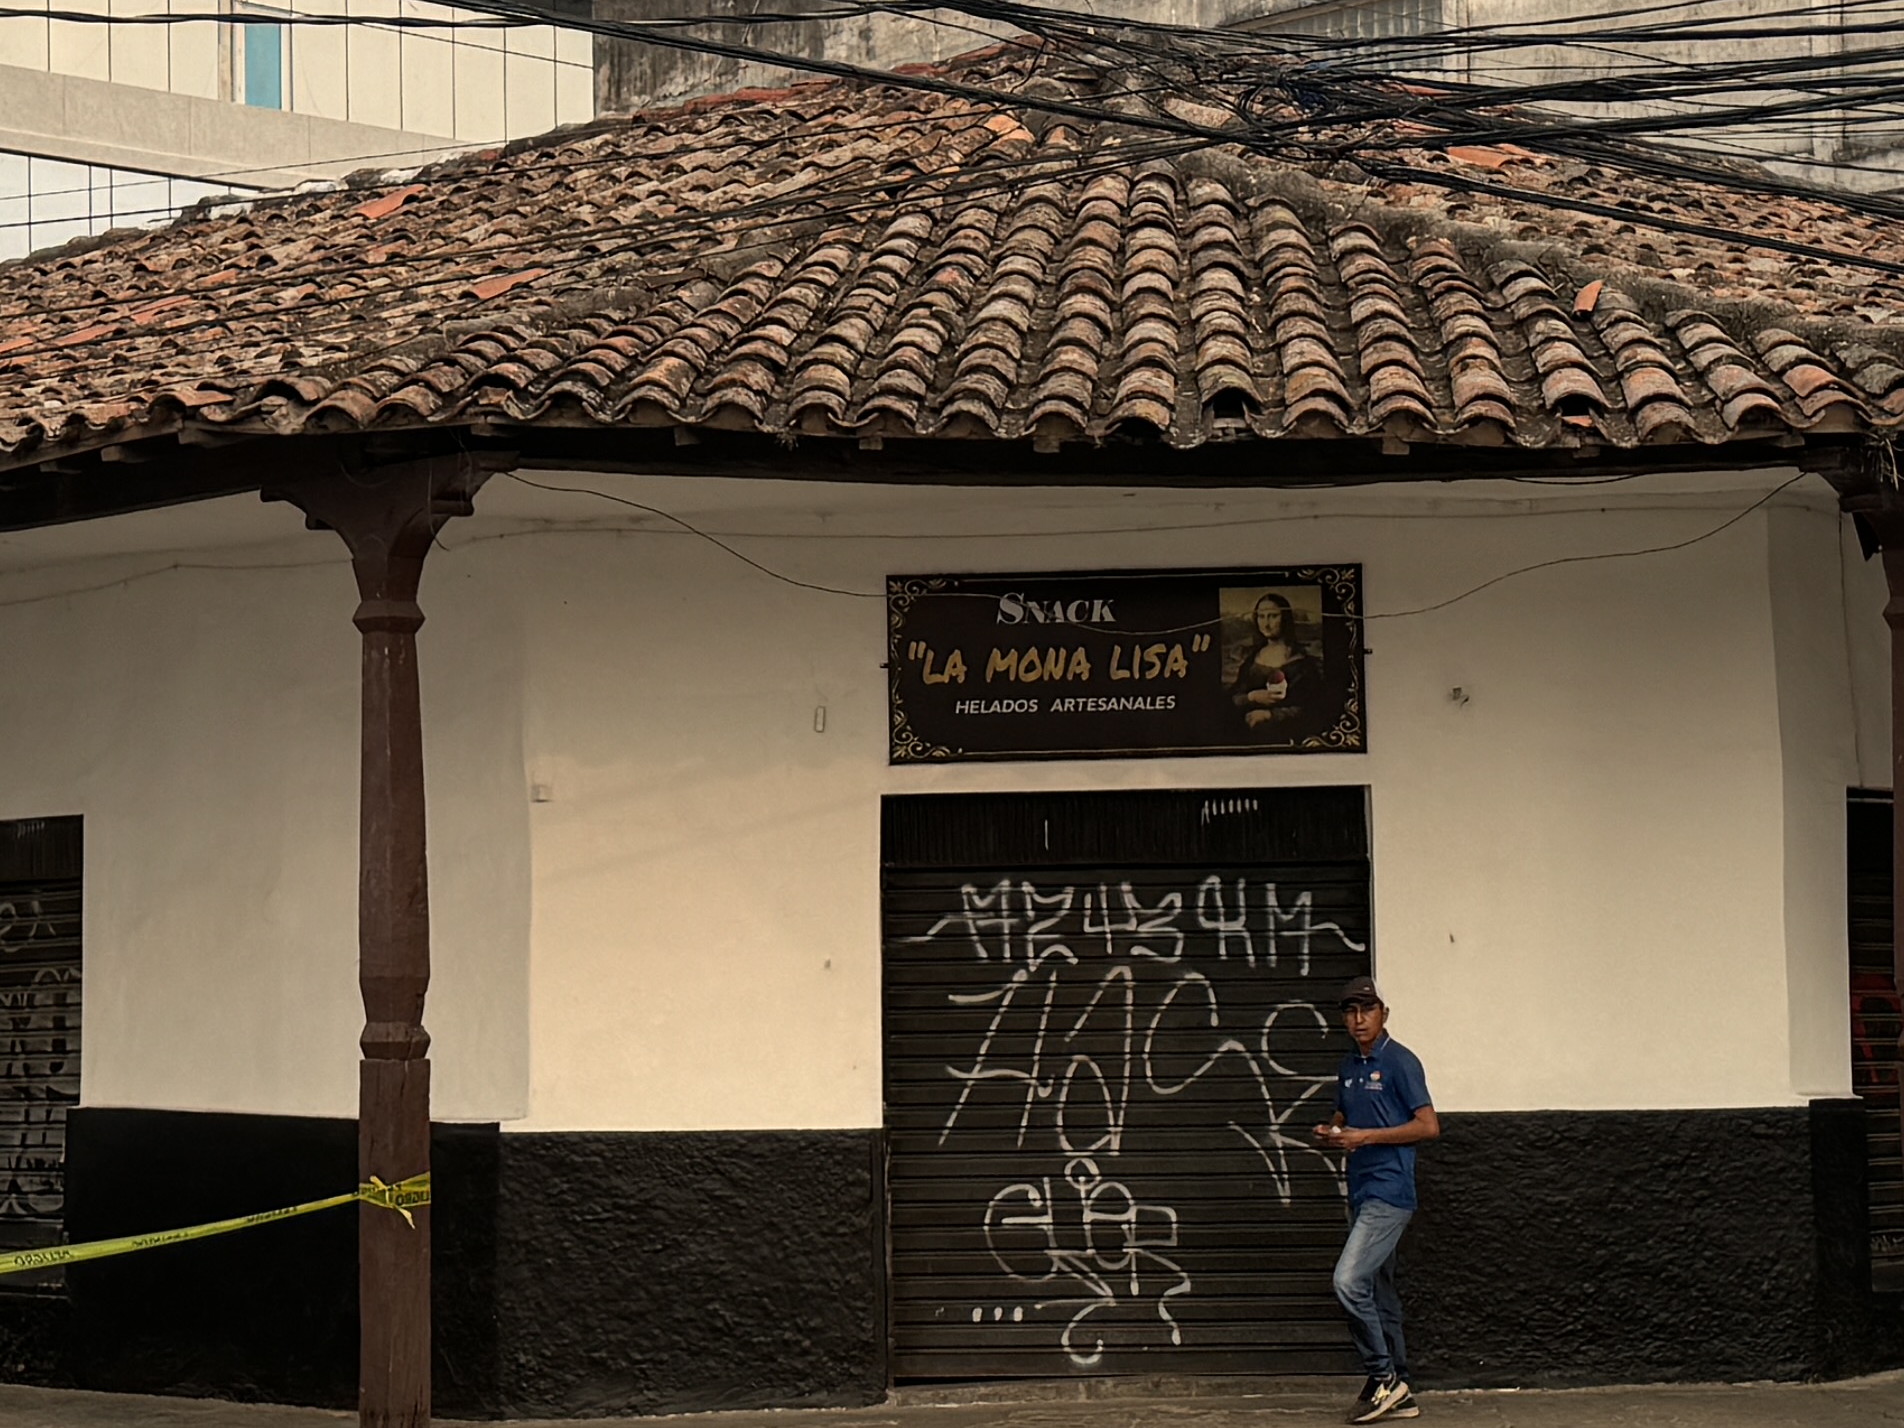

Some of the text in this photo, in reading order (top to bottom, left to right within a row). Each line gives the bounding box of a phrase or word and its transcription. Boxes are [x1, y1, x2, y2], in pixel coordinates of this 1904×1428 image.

[985, 646, 1091, 684] MONA
[955, 695, 1177, 715] HELADOS ARTESANALES
